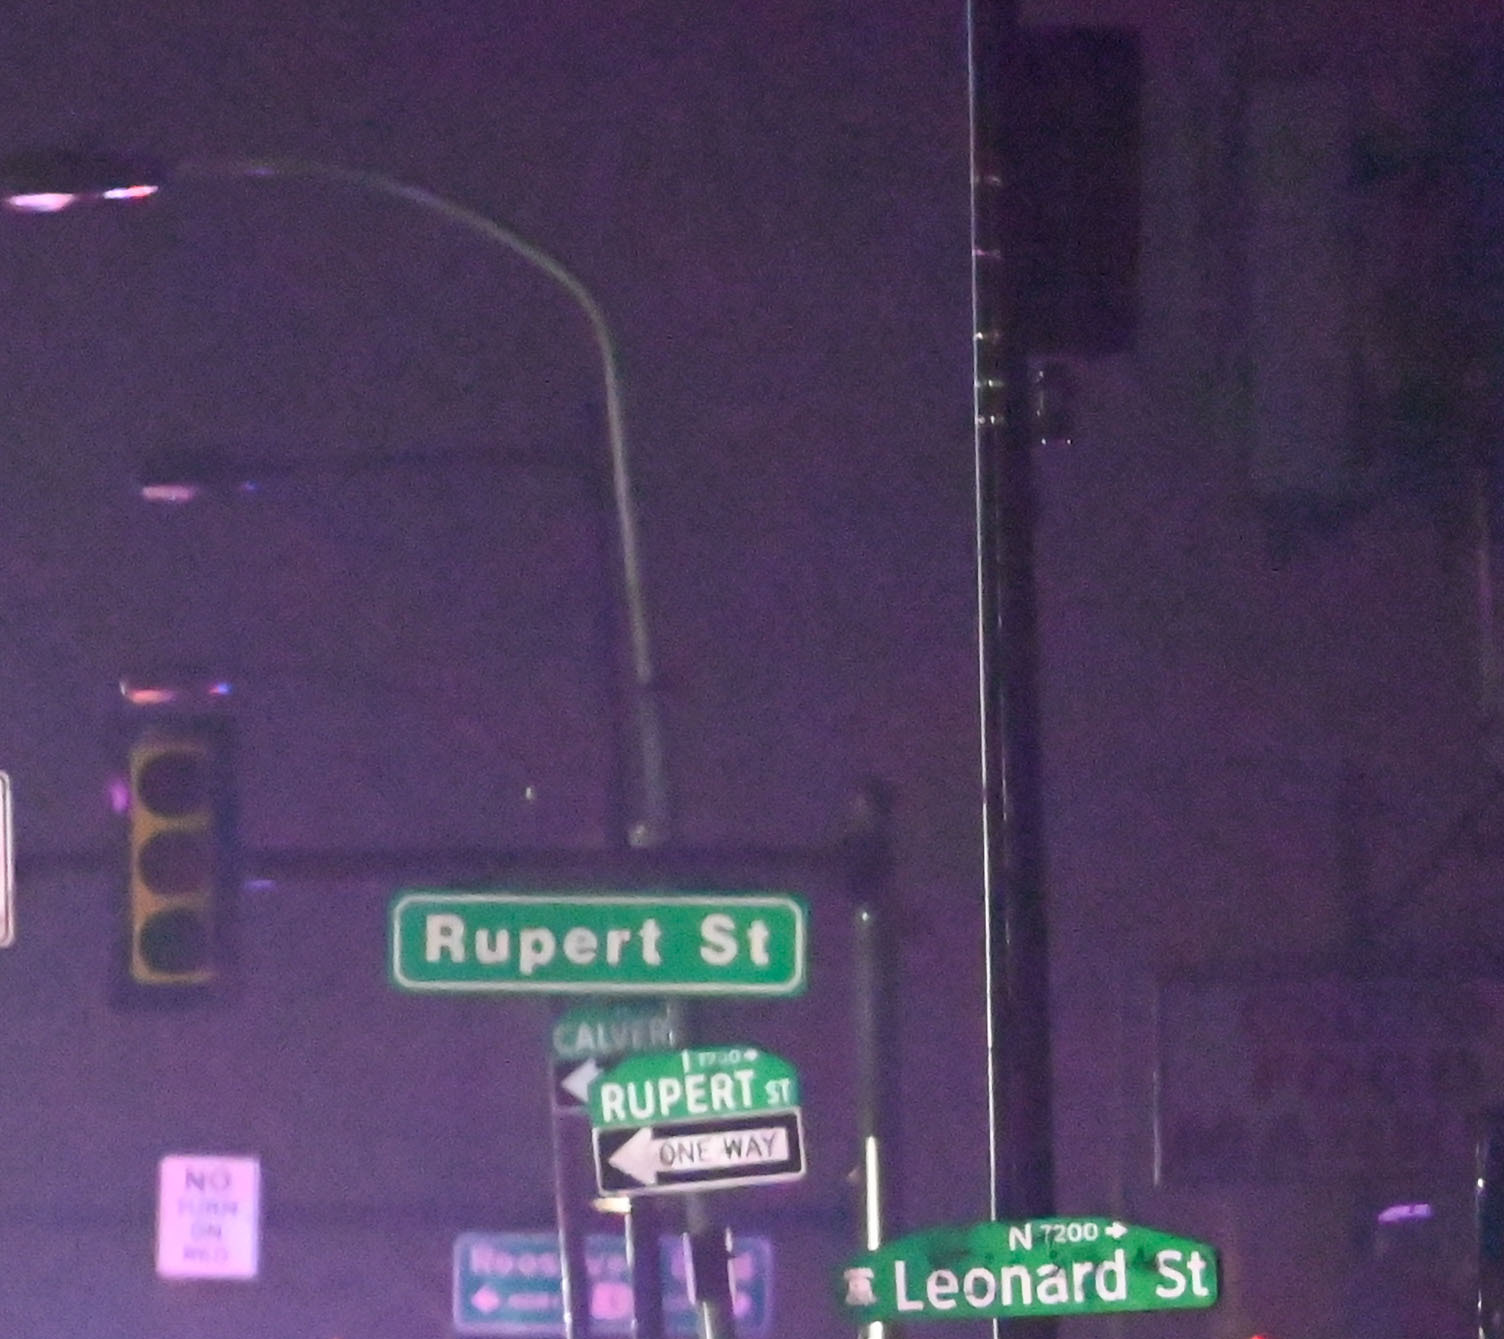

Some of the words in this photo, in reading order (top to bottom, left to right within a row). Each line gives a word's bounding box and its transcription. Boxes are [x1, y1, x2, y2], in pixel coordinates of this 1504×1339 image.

[425, 912, 662, 976] Rupert
[699, 913, 769, 967] St
[552, 1014, 674, 1056] CALVER
[600, 1069, 756, 1123] RUPERT
[764, 1077, 791, 1106] ST
[658, 1138, 707, 1166] ONE
[722, 1132, 777, 1160] WAY
[185, 1165, 232, 1191] NO
[1008, 1222, 1033, 1252] N
[1040, 1221, 1098, 1244] 7200
[893, 1248, 1127, 1312] Leonard
[1154, 1249, 1210, 1298] St
